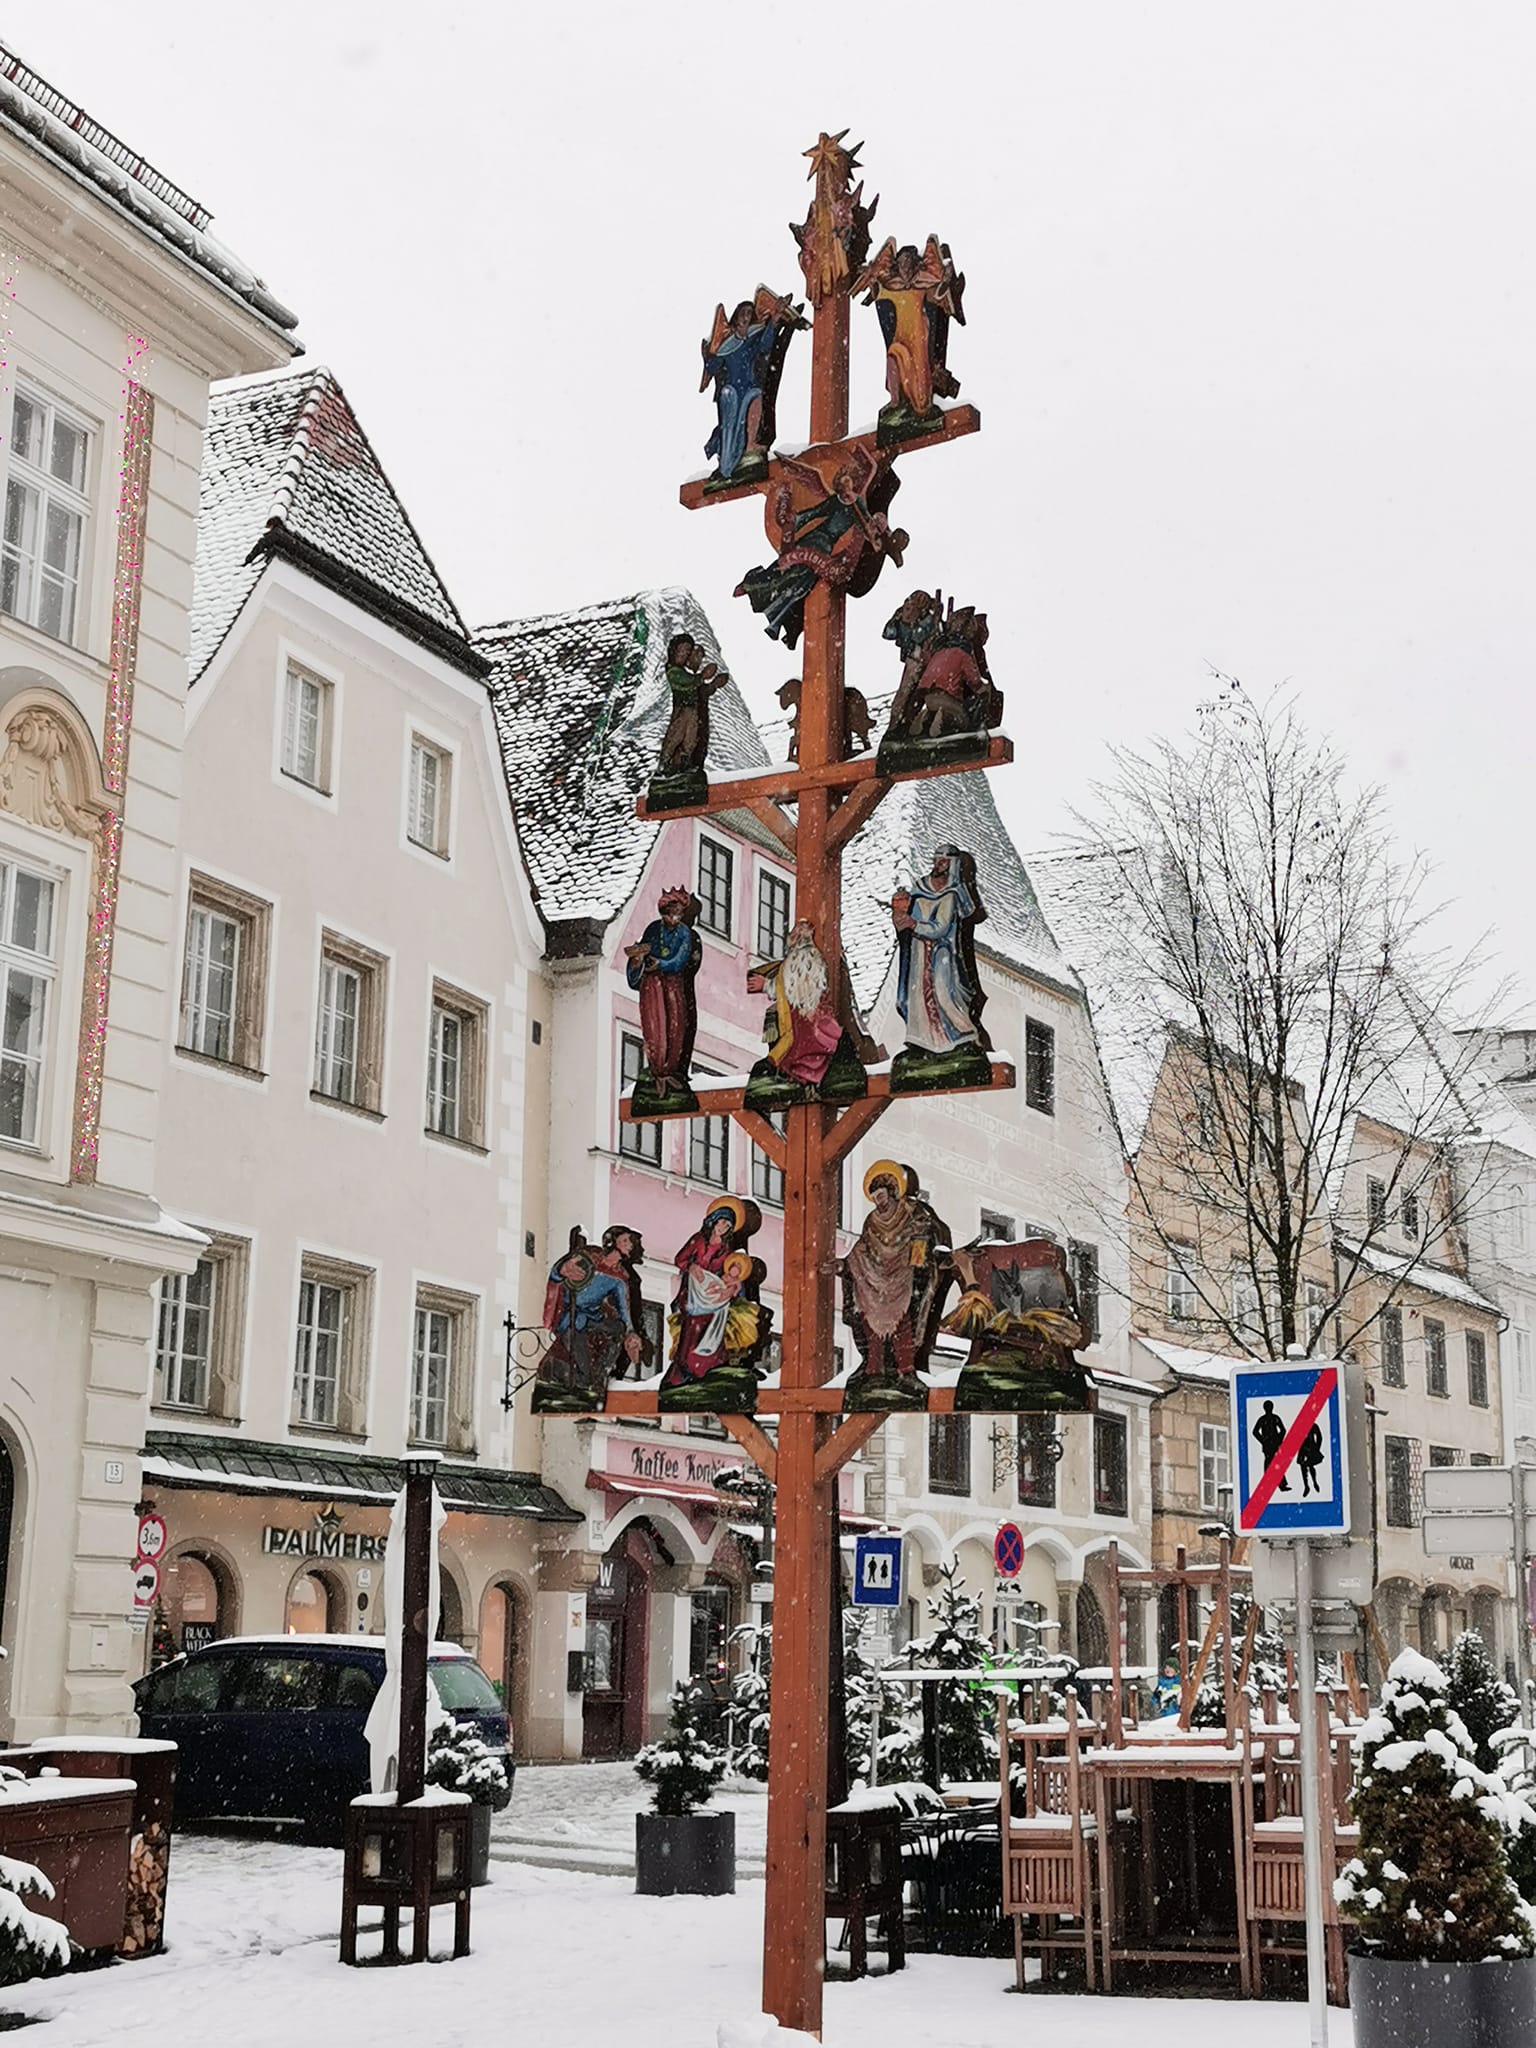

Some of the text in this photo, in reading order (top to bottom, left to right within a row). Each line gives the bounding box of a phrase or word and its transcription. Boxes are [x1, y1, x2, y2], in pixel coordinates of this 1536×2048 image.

[631, 1446, 680, 1481] Kaffee
[263, 1526, 388, 1560] PALMERS
[600, 1562, 614, 1587] W
[185, 1626, 212, 1640] BLACK
